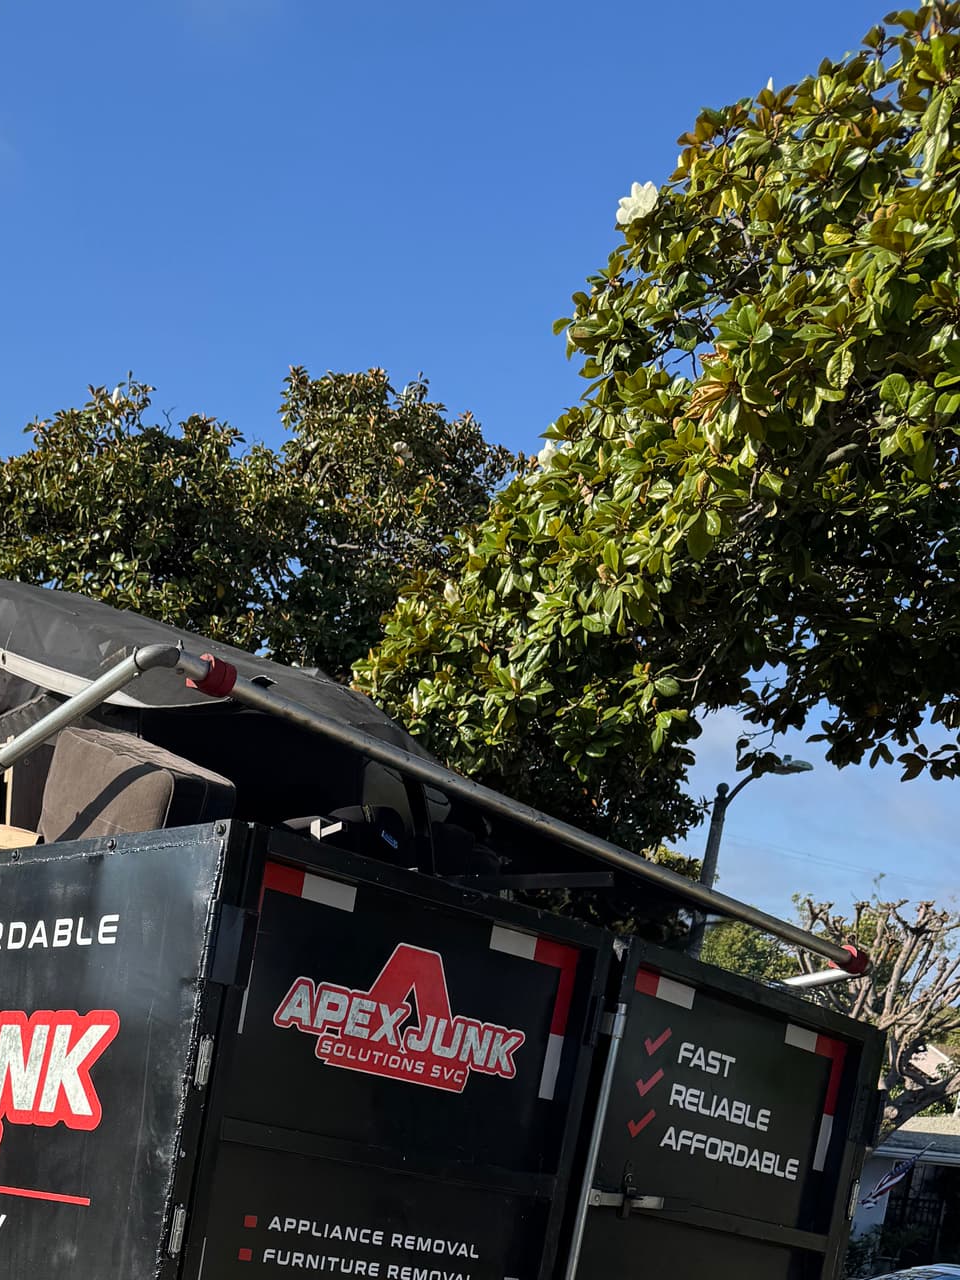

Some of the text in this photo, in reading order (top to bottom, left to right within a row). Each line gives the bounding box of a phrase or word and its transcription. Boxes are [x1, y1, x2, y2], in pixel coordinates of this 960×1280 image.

[278, 983, 525, 1074] APEX JUNK
[319, 1040, 467, 1084] SOLUTIONS SVC
[677, 1041, 737, 1078] FAST
[668, 1082, 772, 1132] RELIABLE
[659, 1126, 800, 1181] AFFORDABLE
[267, 1215, 480, 1259] APPLIANCE REMOVAL
[262, 1248, 381, 1278] FURNITURE
